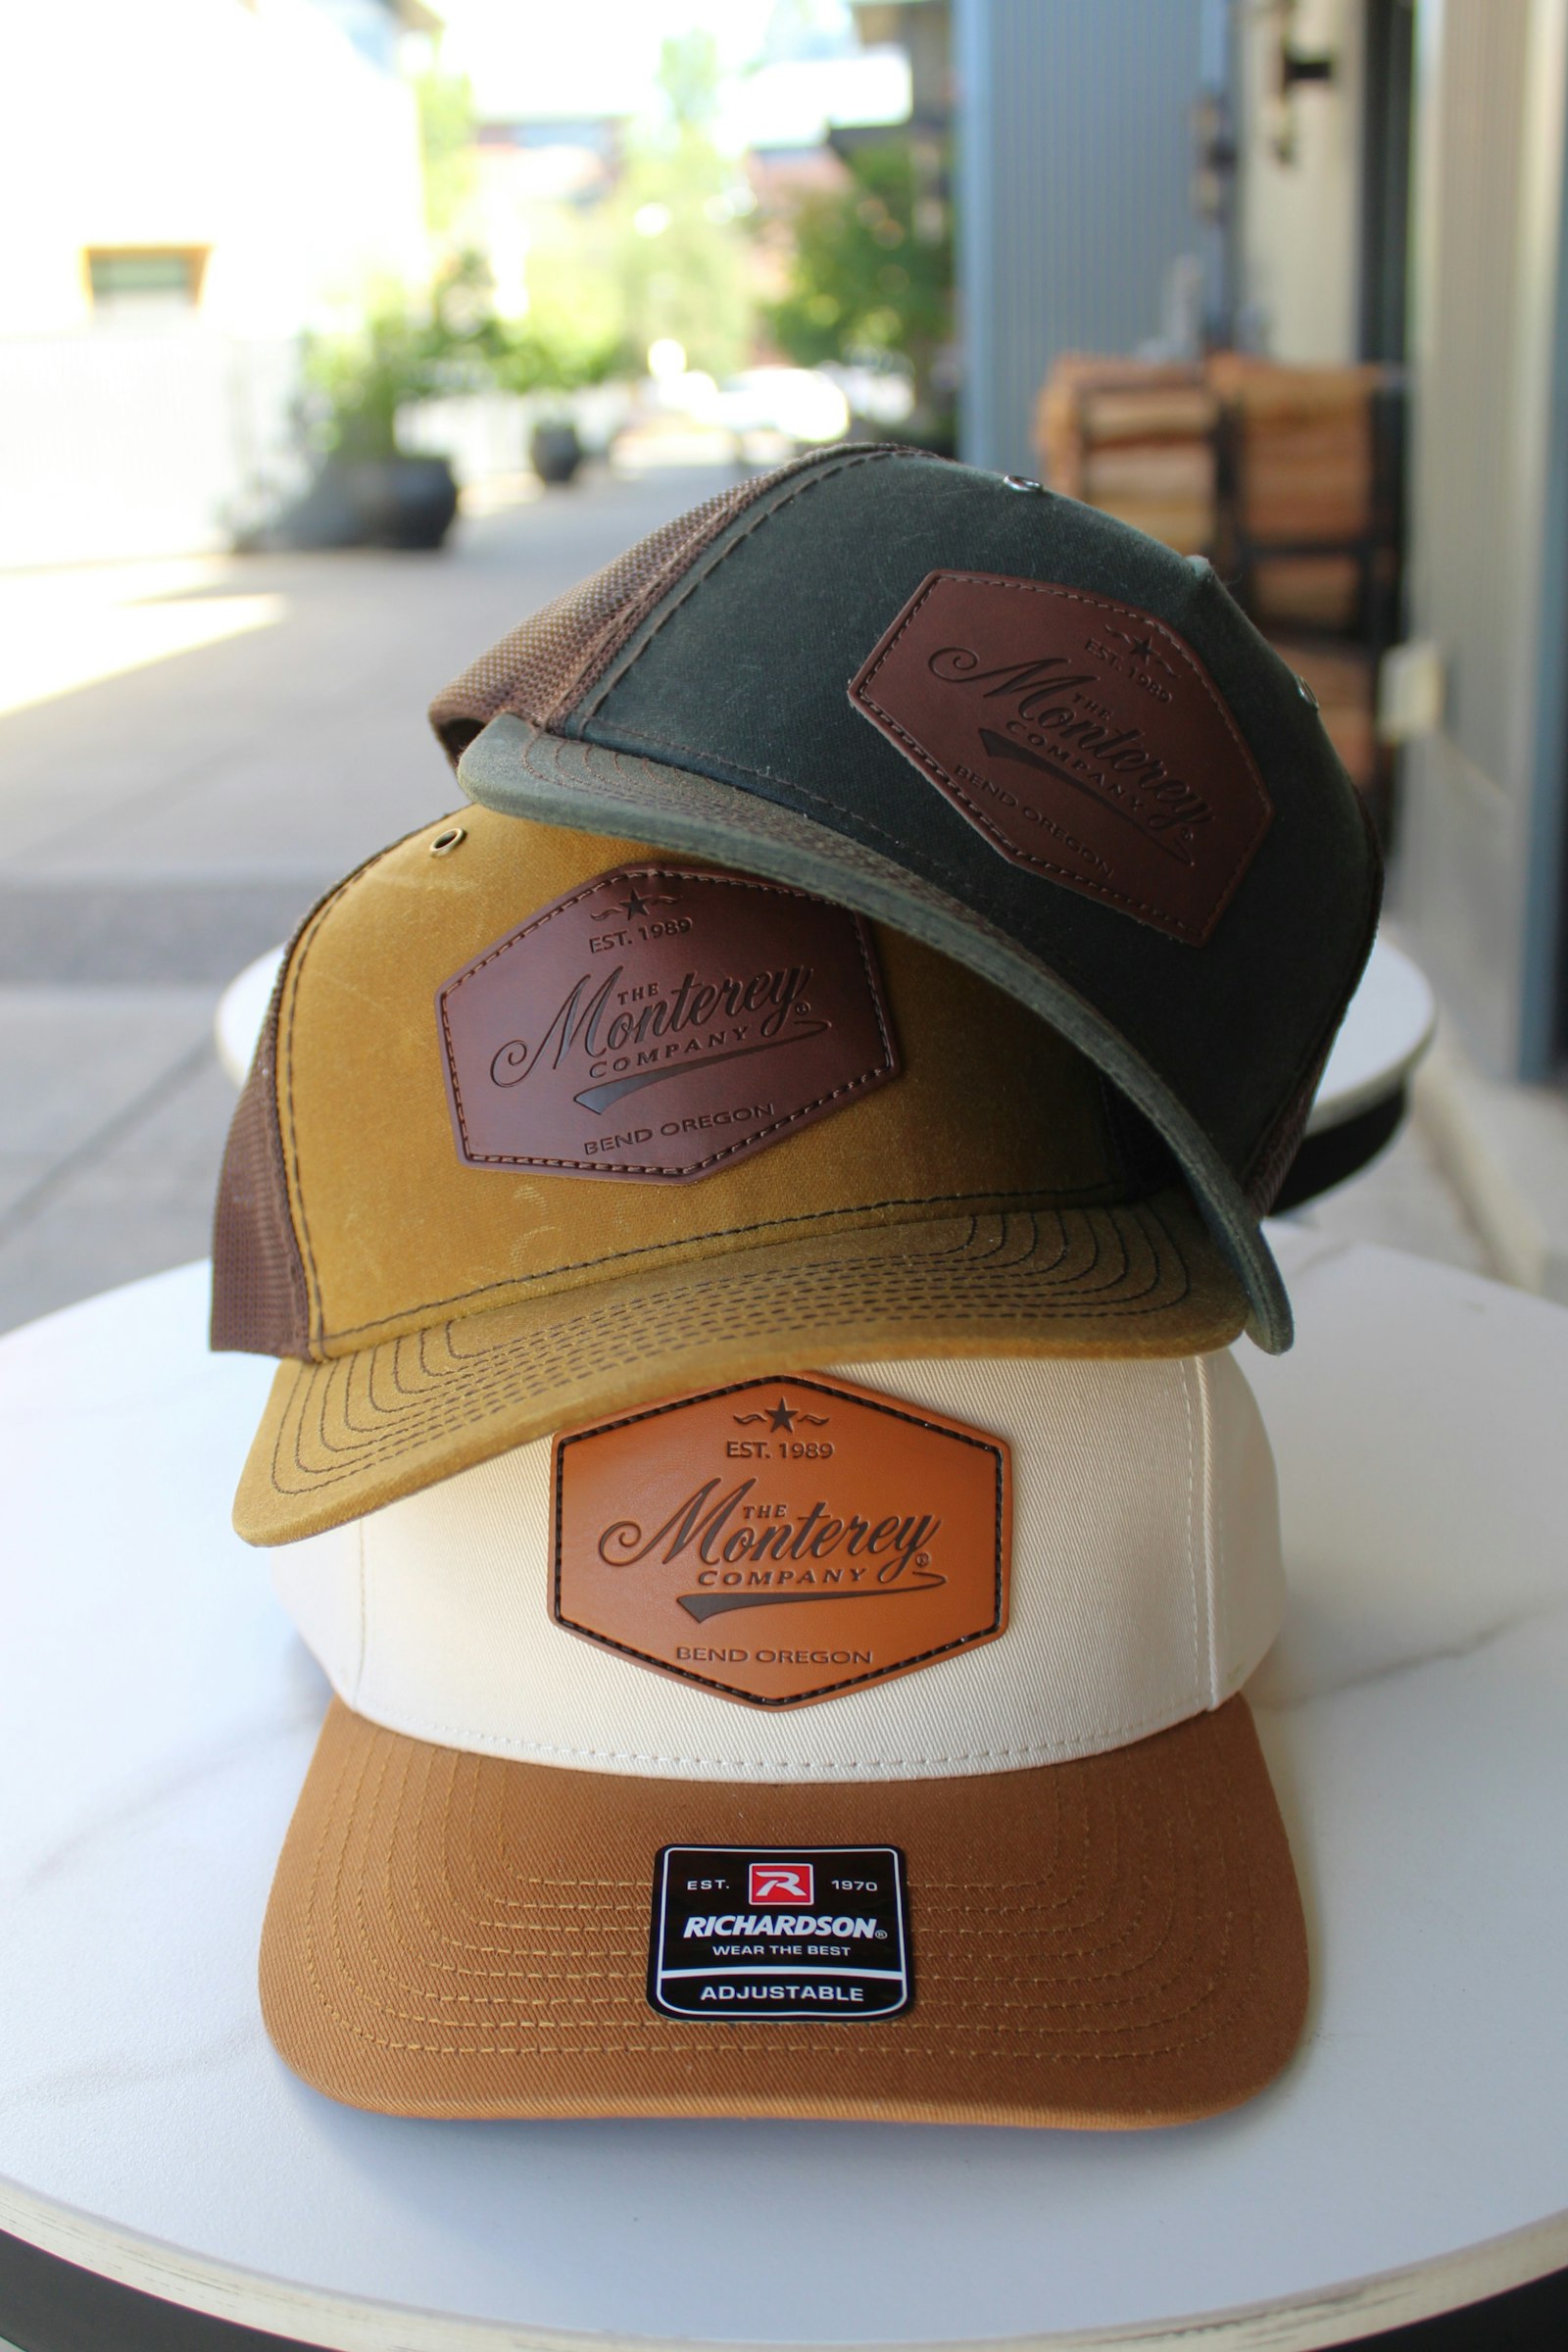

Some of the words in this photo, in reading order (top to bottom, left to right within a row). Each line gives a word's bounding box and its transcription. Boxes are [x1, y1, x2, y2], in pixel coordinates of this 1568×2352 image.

[1084, 637, 1123, 671] EST.
[1128, 664, 1174, 705] 1989
[1073, 692, 1114, 720] THE
[1005, 719, 1148, 812] COMPANY
[954, 763, 1019, 808] BEND
[1022, 806, 1115, 878] OREGON
[589, 932, 634, 955] EST.
[638, 916, 694, 942] 1989
[617, 982, 661, 1005] THE
[589, 1025, 753, 1079] COMPANY
[584, 1127, 655, 1155] BEND
[660, 1102, 775, 1138] OREGON
[726, 1441, 772, 1459] EST.
[779, 1441, 835, 1459] 1989
[742, 1503, 788, 1520] THE
[697, 1568, 867, 1588] COMPANY
[675, 1646, 750, 1663] BEND
[755, 1647, 873, 1665] OREGON
[686, 1879, 730, 1891] EST.
[831, 1879, 879, 1892] 1970
[711, 1944, 765, 1957] WEAR
[768, 1944, 804, 1956] THE
[807, 1945, 852, 1957] BEST
[700, 1985, 865, 2003] ADJUSTABLE
